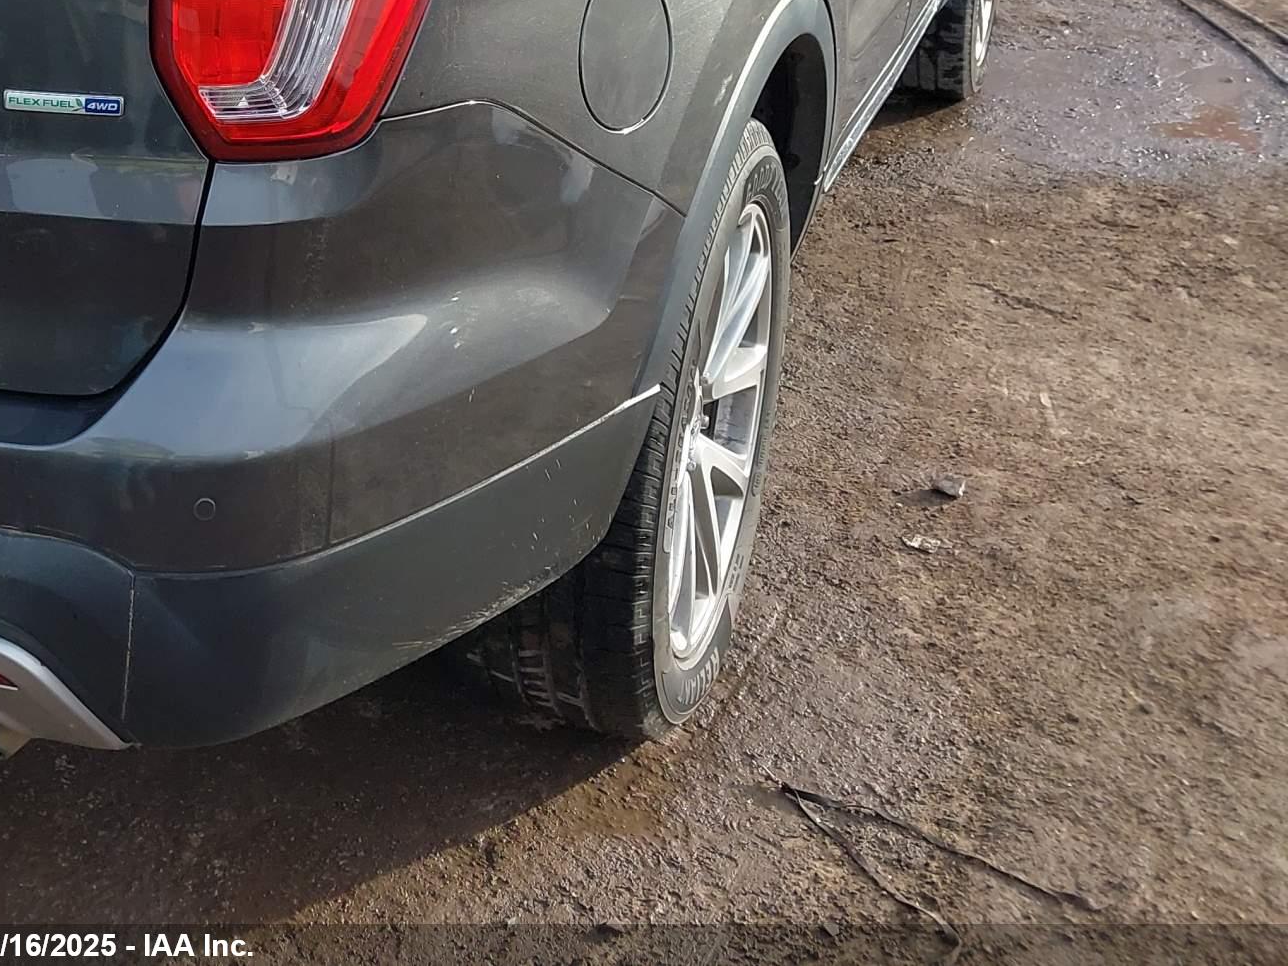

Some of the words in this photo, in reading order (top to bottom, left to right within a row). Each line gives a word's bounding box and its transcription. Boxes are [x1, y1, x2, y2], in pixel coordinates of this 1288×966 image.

[8, 95, 41, 107] FLEX
[42, 98, 75, 109] FUEL
[86, 101, 119, 112] 4WD
